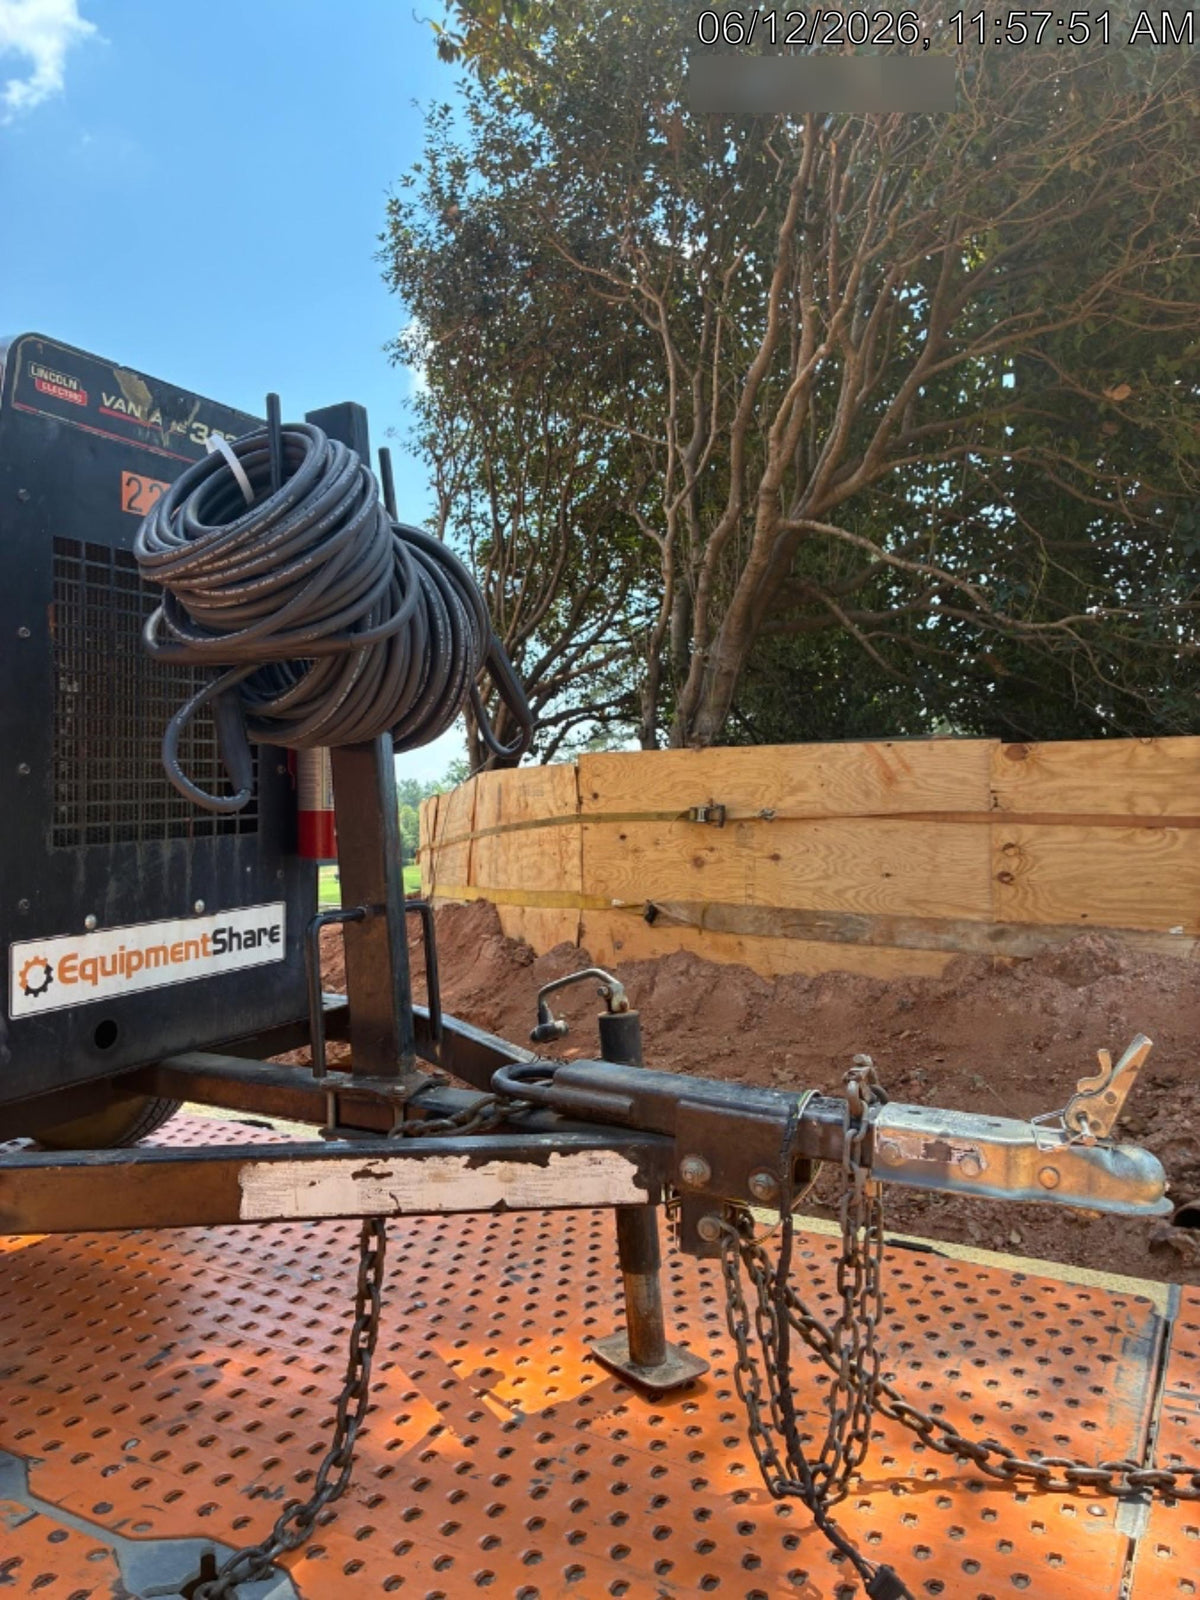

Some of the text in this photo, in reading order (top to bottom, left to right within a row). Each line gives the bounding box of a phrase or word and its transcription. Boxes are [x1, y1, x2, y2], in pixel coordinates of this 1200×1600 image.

[30, 363, 78, 390] LINCOLN
[41, 381, 83, 403] ELECTRIC
[57, 924, 281, 987] EquipmentShare
